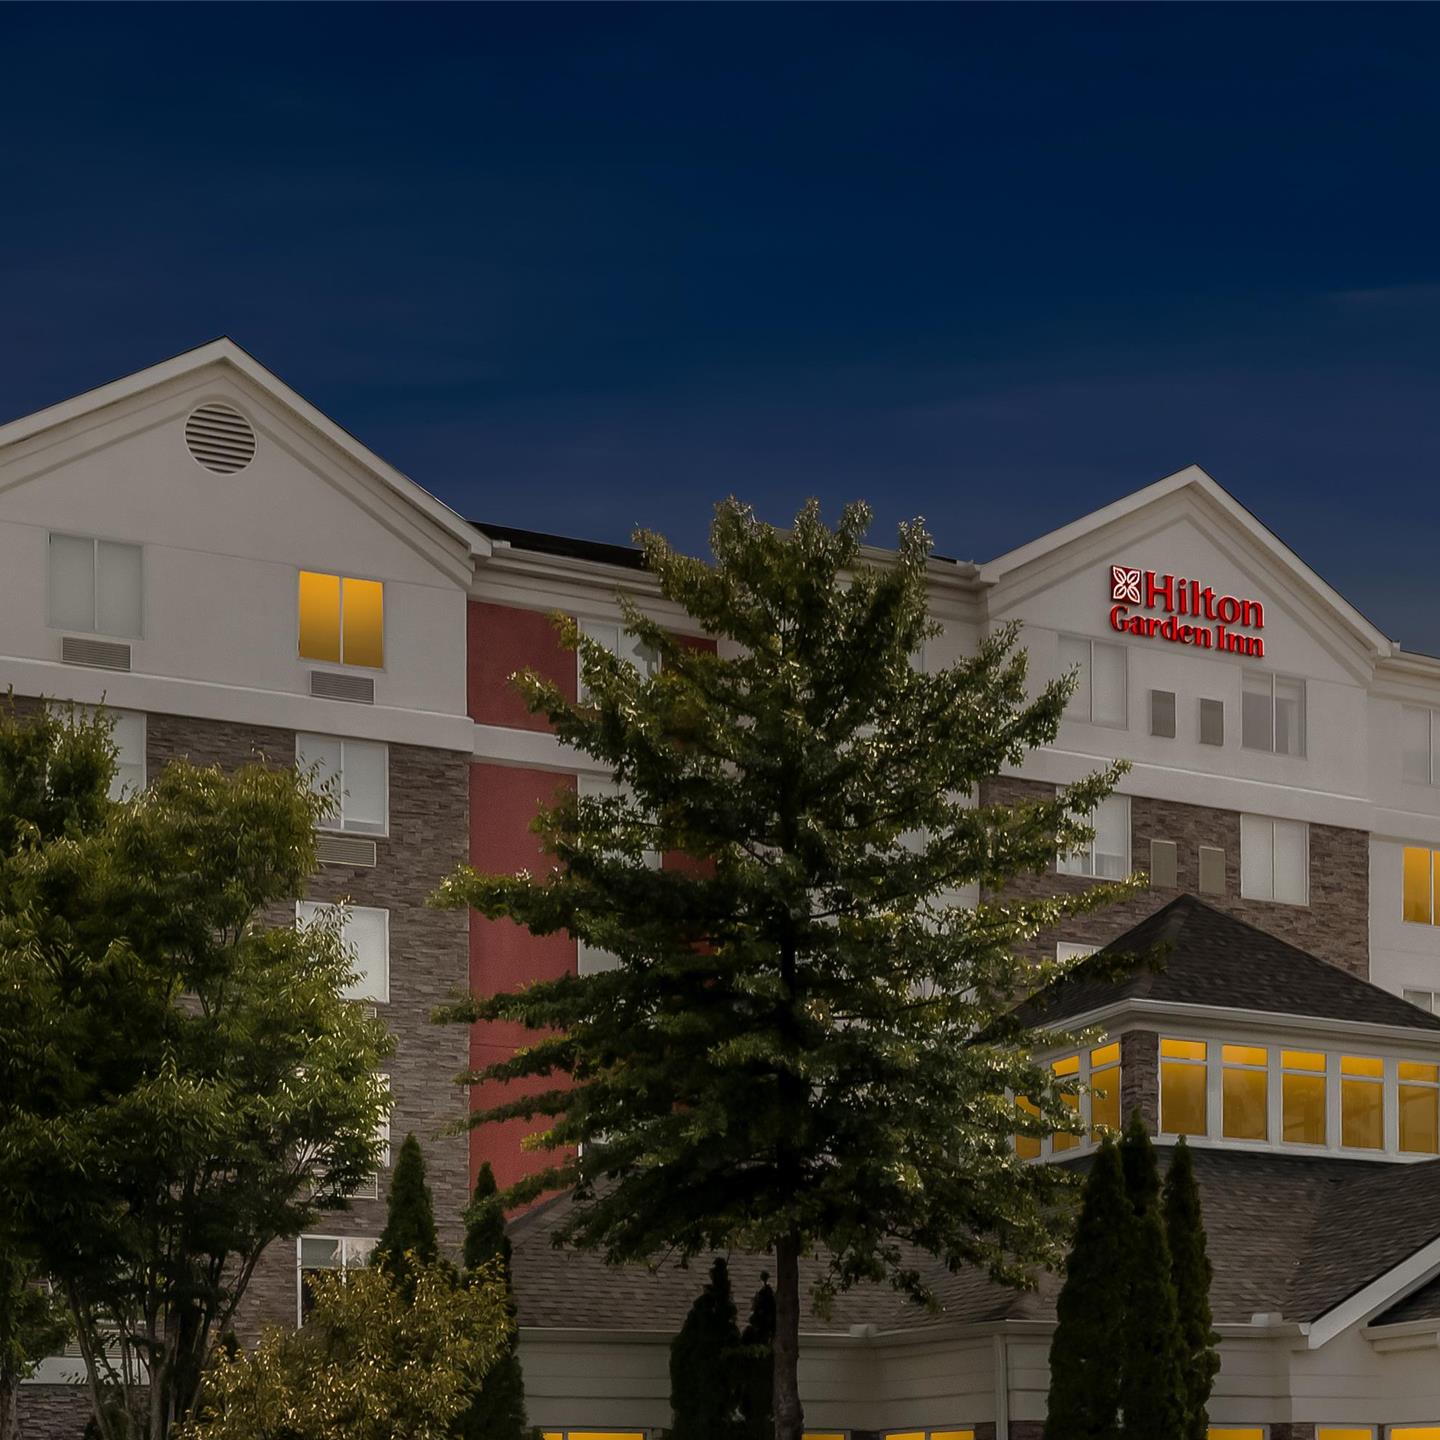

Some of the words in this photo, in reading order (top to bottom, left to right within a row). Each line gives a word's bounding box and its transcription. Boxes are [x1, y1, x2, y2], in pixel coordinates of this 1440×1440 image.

[1145, 570, 1264, 628] Hilton
[1110, 605, 1212, 648] Garden
[1216, 625, 1264, 657] Inn
